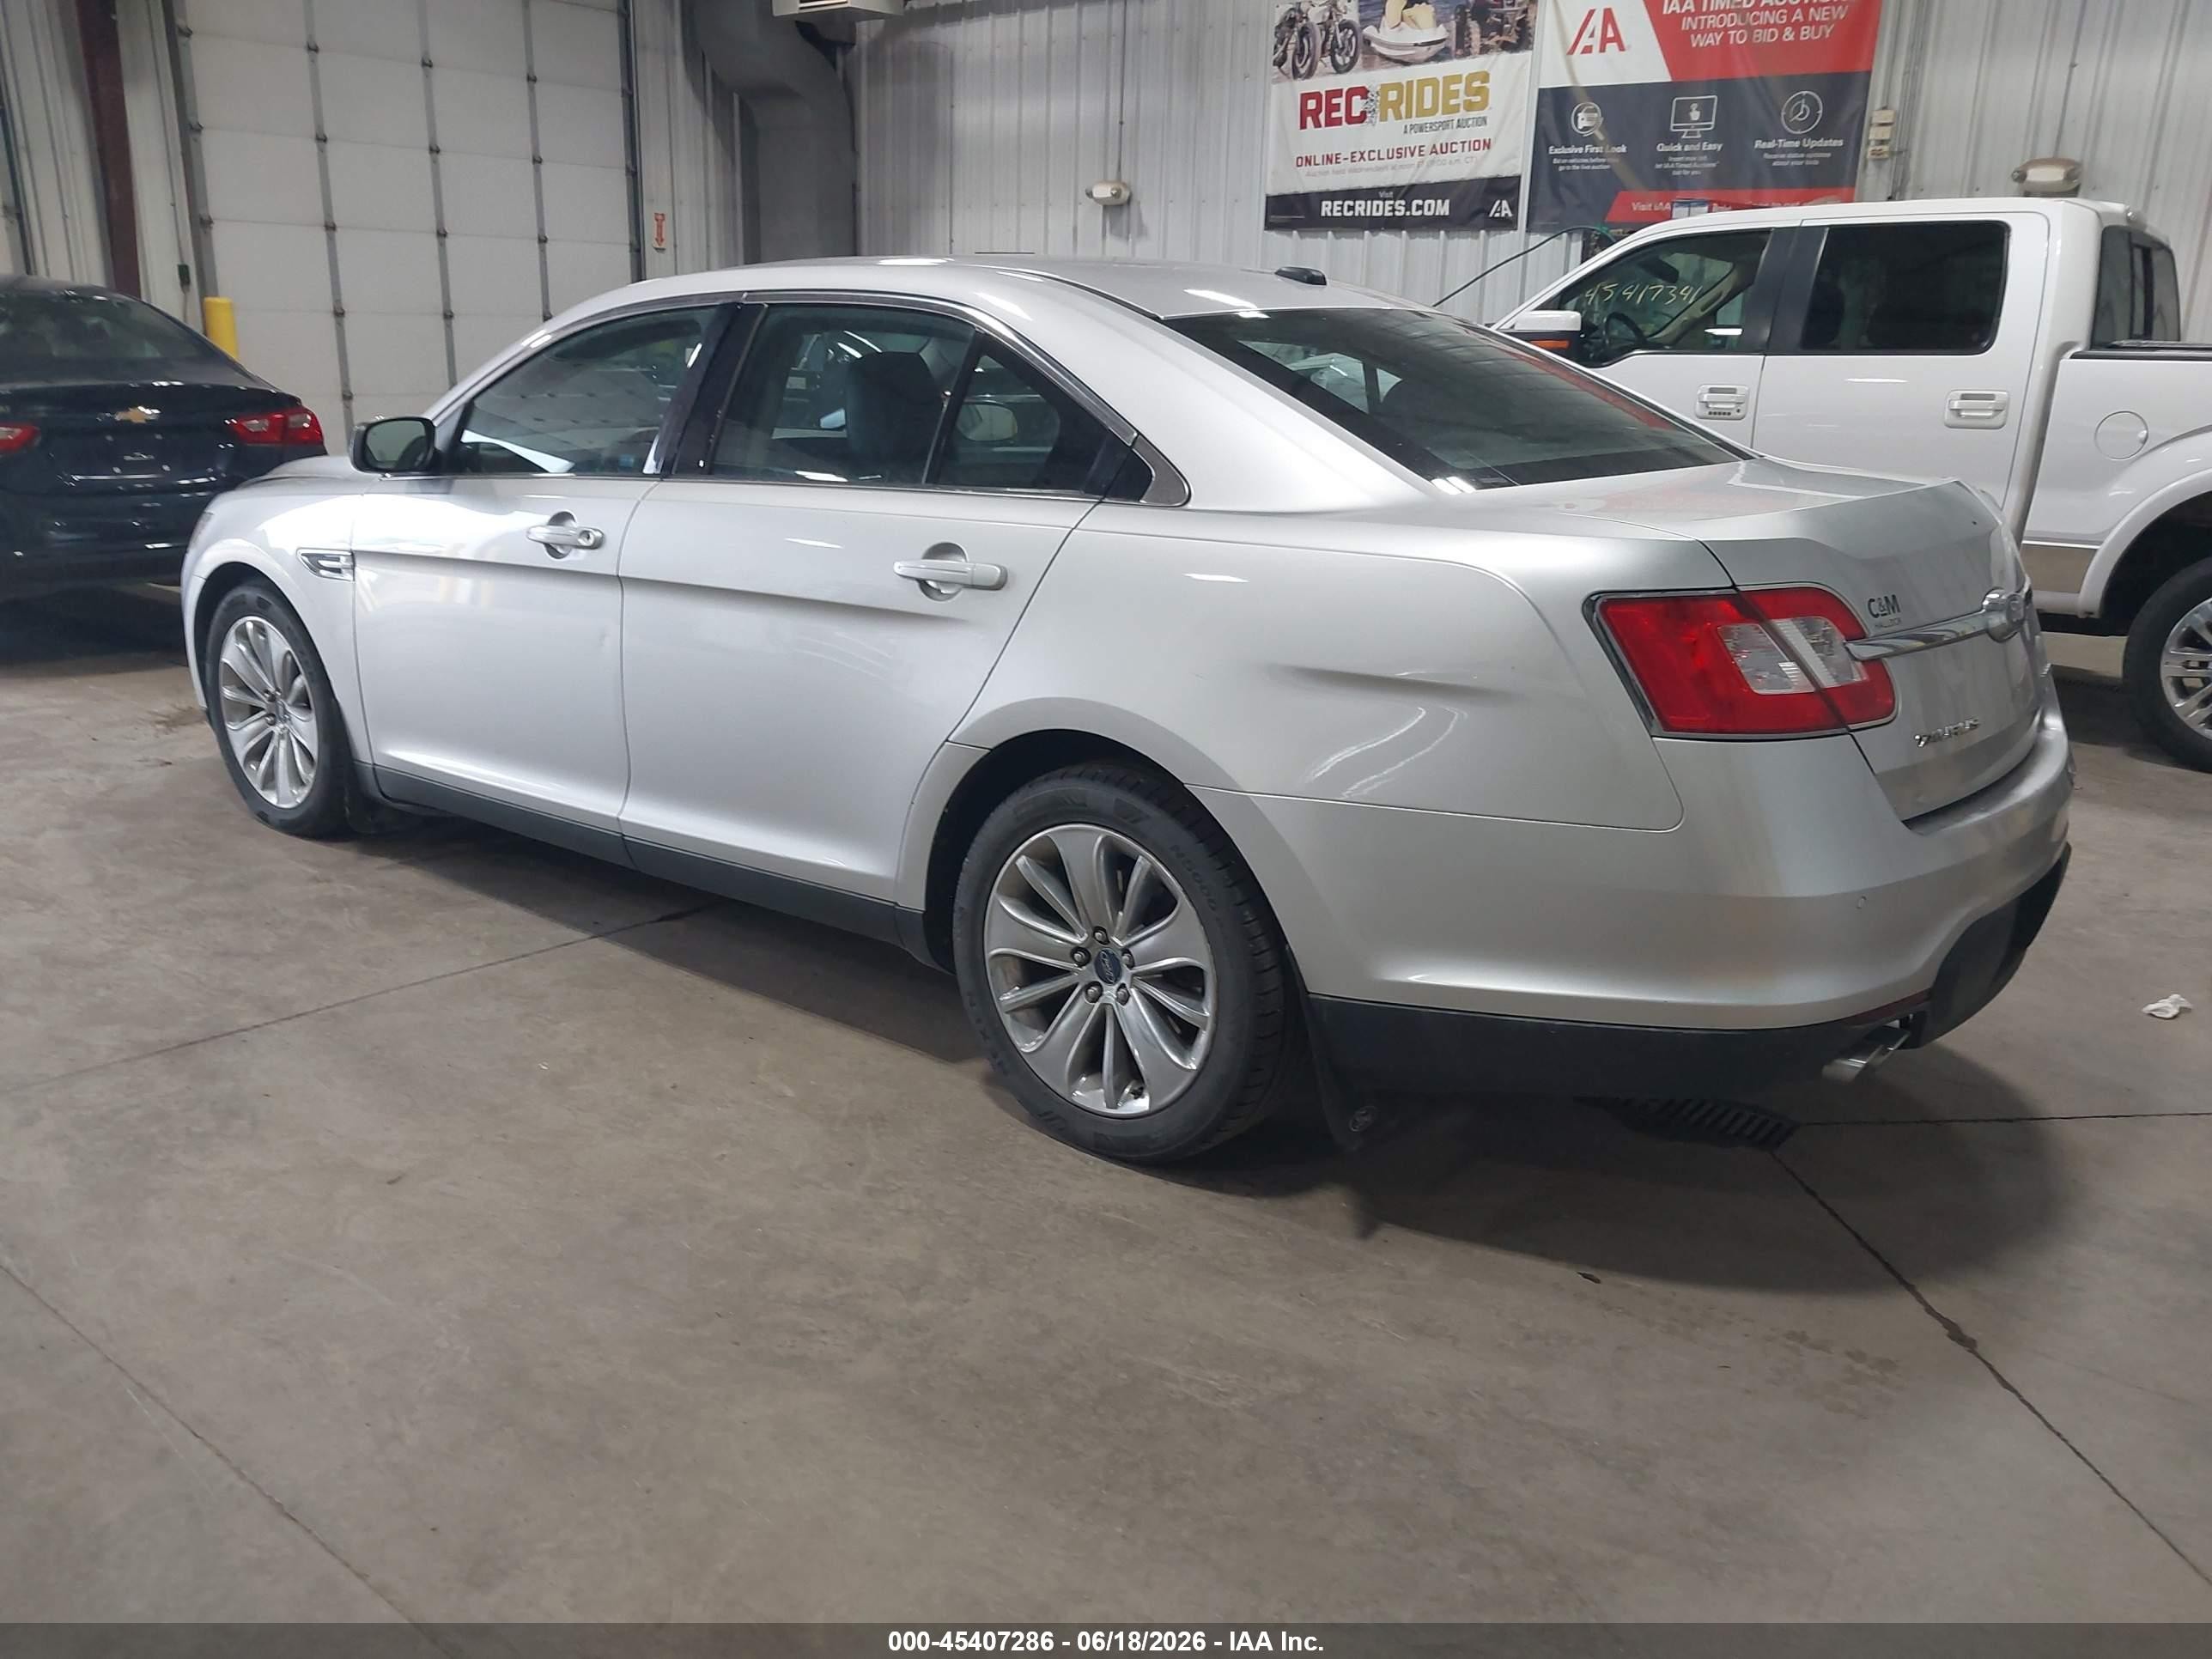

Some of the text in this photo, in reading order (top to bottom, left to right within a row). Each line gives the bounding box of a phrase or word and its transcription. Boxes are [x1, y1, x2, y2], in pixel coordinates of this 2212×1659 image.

[1681, 5, 1849, 30] INTRODUCING A NEW
[1690, 24, 1834, 47] WAY TO BID & BUY
[1299, 70, 1490, 130] REC RIDES
[1403, 116, 1488, 134] A POWERSPORT AUCTION
[1296, 145, 1425, 167] ONLINE-EXCLUSIVE
[1429, 138, 1492, 155] AUCTION
[1548, 145, 1583, 155] Exclusive
[1584, 144, 1604, 153] First
[1656, 141, 1724, 152] Quick and Easy
[1754, 137, 1844, 149] Real-Time Updates
[1321, 198, 1450, 217] RECRIDES.COM
